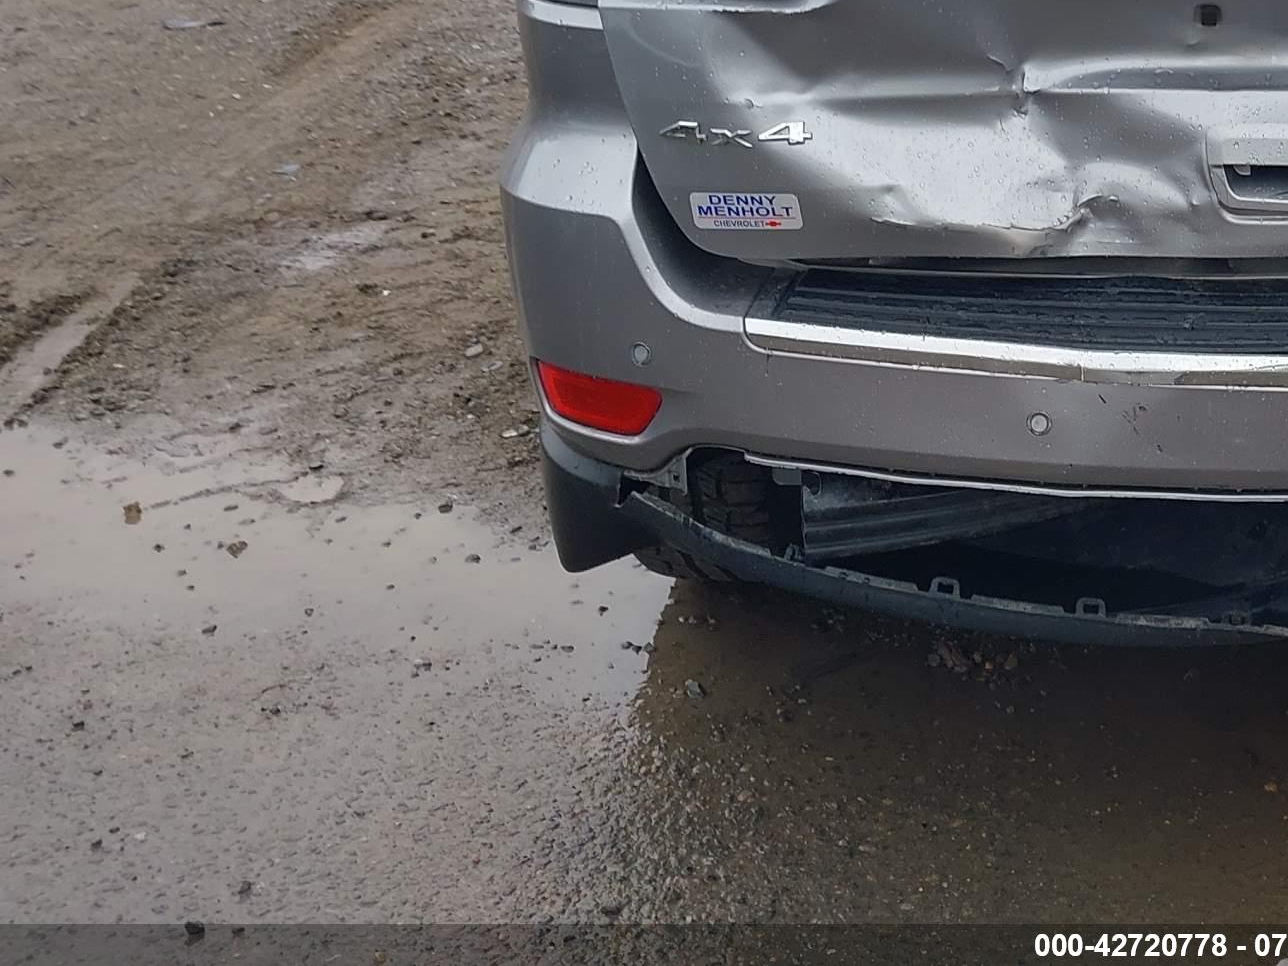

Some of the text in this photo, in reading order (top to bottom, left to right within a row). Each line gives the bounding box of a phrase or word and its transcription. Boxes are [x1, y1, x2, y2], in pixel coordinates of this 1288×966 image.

[659, 120, 812, 148] 4x4
[708, 194, 777, 206] DENNY
[697, 206, 793, 217] MENHOLT
[713, 220, 765, 228] CHEVROLET
